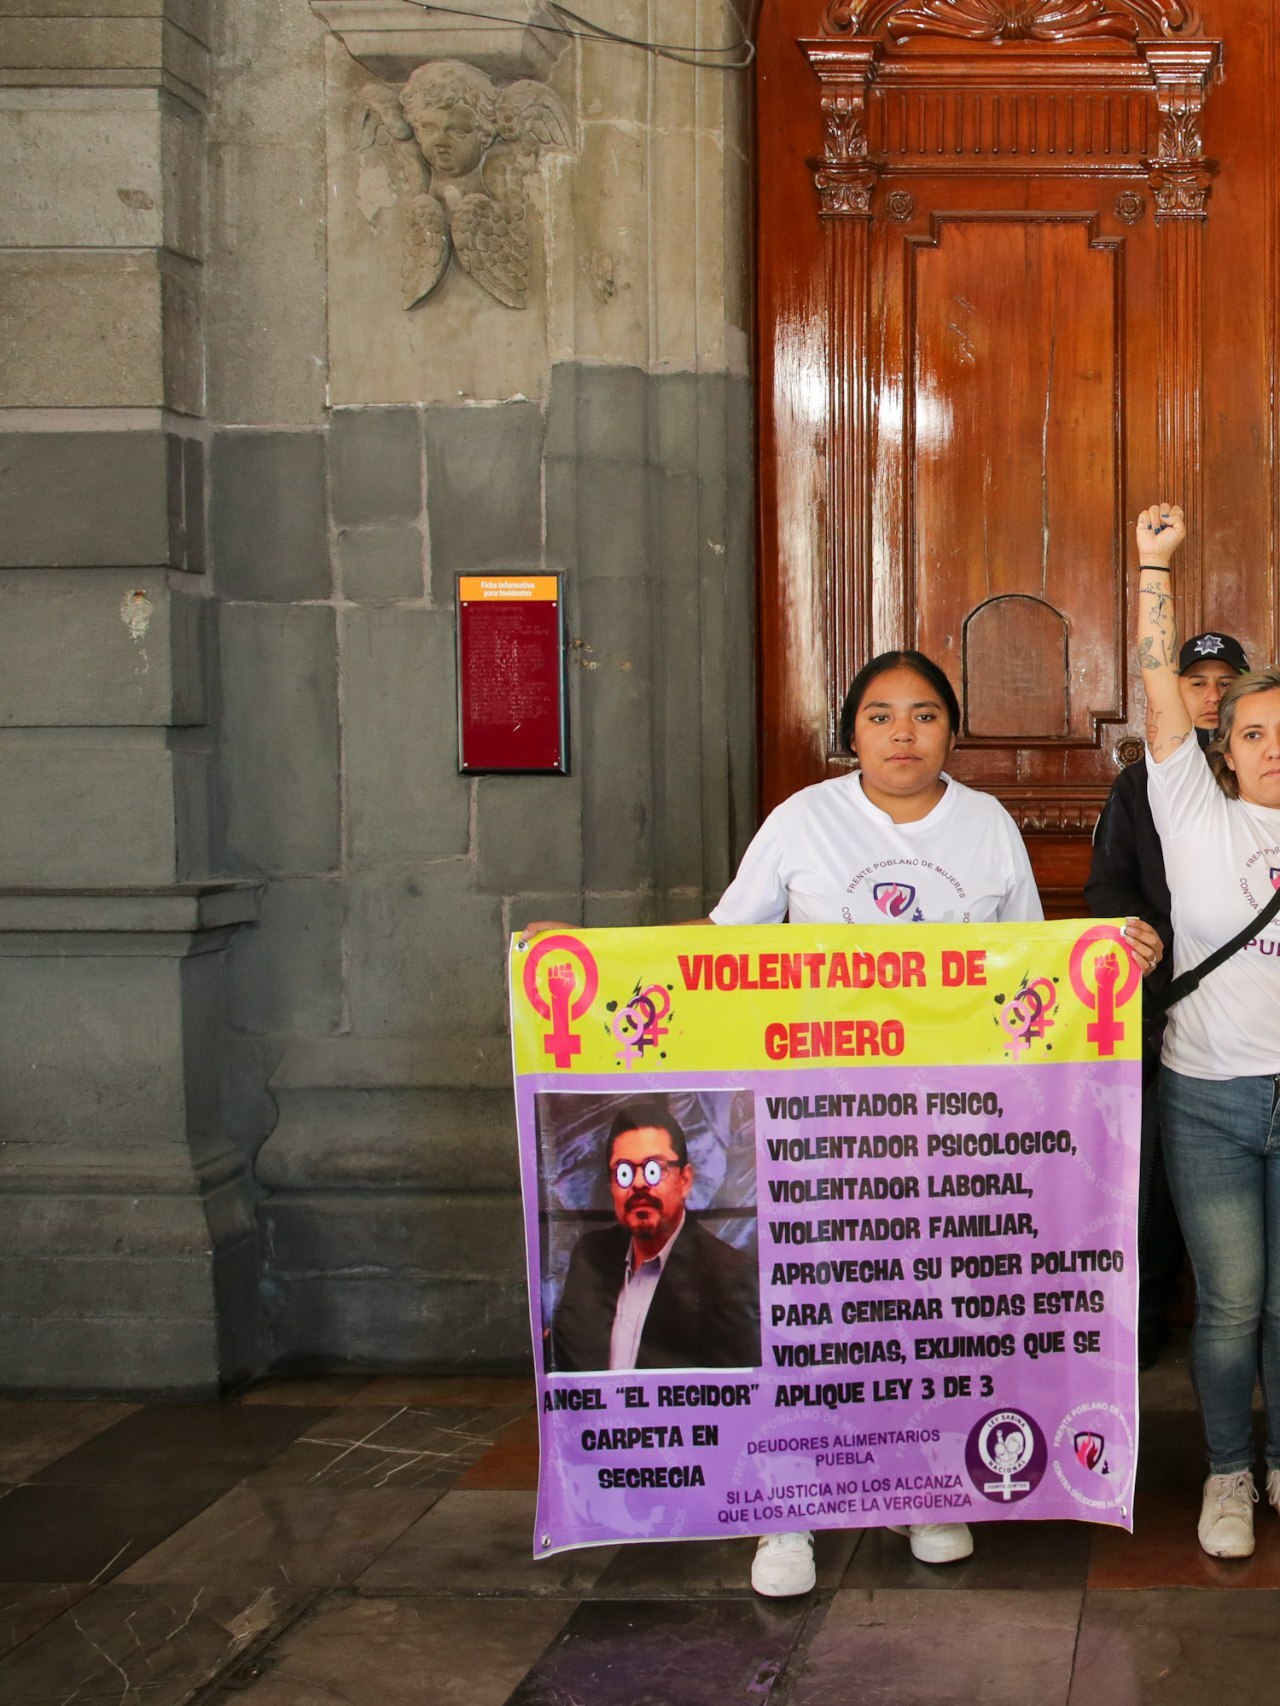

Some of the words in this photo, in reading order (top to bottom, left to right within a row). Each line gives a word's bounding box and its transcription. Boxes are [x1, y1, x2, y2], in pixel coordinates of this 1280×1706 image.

[846, 867, 875, 895] FRENTE
[872, 858, 920, 872] POBLANO
[921, 859, 934, 870] DE
[934, 865, 966, 900] MUJERES
[1239, 876, 1260, 911] CONTRA
[677, 950, 927, 992] VIOLENTADOR
[942, 949, 988, 987] DE
[764, 1019, 906, 1061] GENERO
[765, 1092, 918, 1121] VIOLENTADOR
[926, 1091, 1004, 1118] FISICO,
[766, 1134, 919, 1162] VIOLENTADOR
[927, 1129, 1077, 1158] PSICOLOGICO,
[768, 1175, 920, 1204] VIOLENTADOR
[928, 1172, 1034, 1199] LABORAL,
[769, 1217, 921, 1245] VIOLENTADOR
[929, 1213, 1039, 1240] FAMILIAR,
[771, 1259, 904, 1286] APROVECHA
[913, 1257, 942, 1281] SU
[950, 1253, 1023, 1279] PODER
[1031, 1249, 1124, 1275] POLITICO
[771, 1301, 833, 1327] PARA
[841, 1297, 943, 1325] GENERAR
[952, 1293, 1026, 1319] TODAS
[1033, 1290, 1105, 1315] ESTAS
[772, 1339, 907, 1368] VIOLENCIAS,
[914, 1333, 1016, 1360] EXIJIMOS
[1023, 1331, 1066, 1359] QUE
[1073, 1330, 1101, 1353] SE
[543, 1388, 607, 1414] ANGEL
[775, 1382, 865, 1409] APLIQUE
[873, 1378, 913, 1402] LEY
[921, 1377, 936, 1400] 3
[943, 1375, 972, 1398] DE
[980, 1375, 994, 1397] 3
[1001, 1414, 1026, 1428] SABINA
[581, 1425, 684, 1451] CARPETA
[692, 1425, 719, 1446] EN
[747, 1435, 829, 1455] DEUDORES
[832, 1429, 940, 1448] ALIMENTARIOS
[815, 1451, 875, 1467] PUEBLA
[598, 1465, 705, 1489] SECRECIA
[726, 1491, 742, 1506] SI
[744, 1489, 764, 1504] LA
[767, 1482, 832, 1502] JUSTICIA
[836, 1480, 858, 1496] NO
[862, 1478, 892, 1493] LOS
[895, 1475, 963, 1491] ALCANZA
[718, 1508, 750, 1524] QUE
[754, 1504, 783, 1520] LOS
[787, 1499, 857, 1518] ALCANCE
[861, 1497, 880, 1513] LA
[883, 1492, 972, 1511] VERGÜENZA
